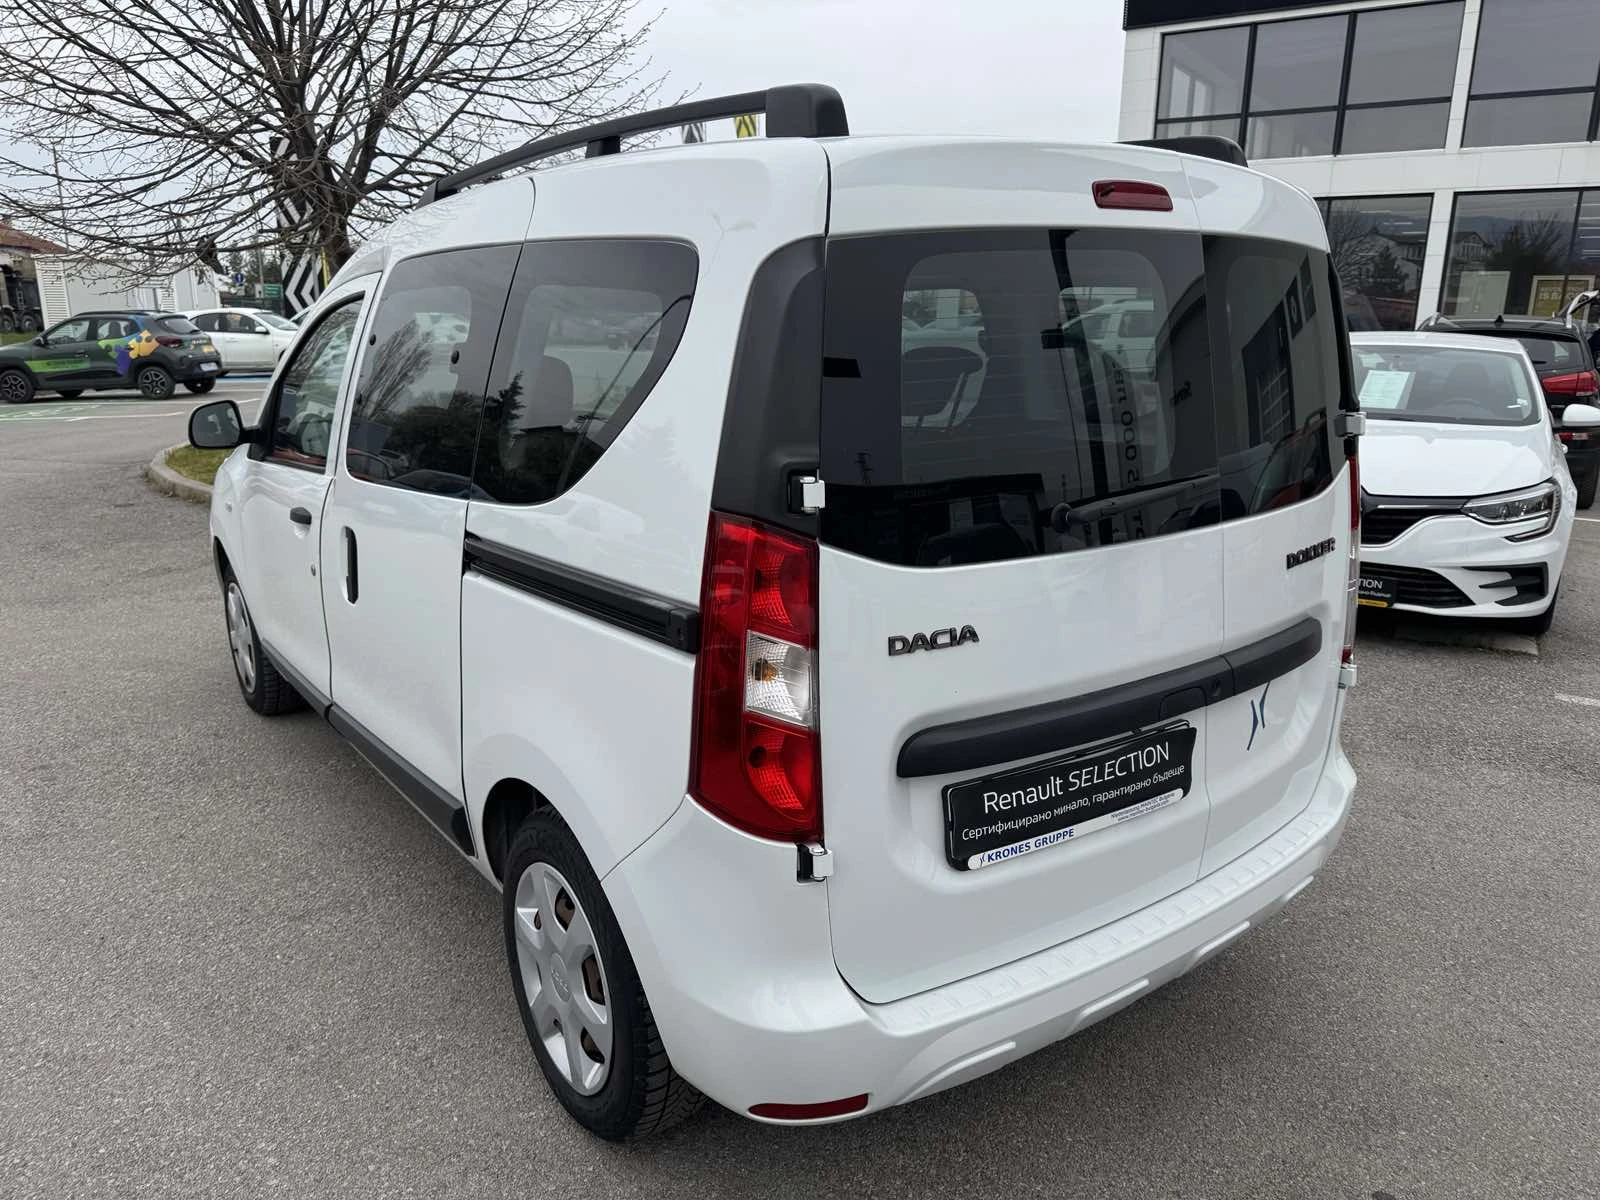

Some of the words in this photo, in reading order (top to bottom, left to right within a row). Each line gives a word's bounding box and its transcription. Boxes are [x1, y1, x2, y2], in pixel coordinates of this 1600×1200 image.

[1286, 537, 1336, 570] DOKKER
[1357, 578, 1383, 589] TION
[888, 625, 980, 656] DACIA
[984, 776, 1064, 814] Renault
[1068, 741, 1170, 791] SELECTION
[962, 810, 1052, 841] Сертифицирано
[1053, 796, 1091, 817] минало,
[1092, 779, 1151, 804] гарантирано
[1152, 765, 1185, 784] бъдеще
[987, 839, 1031, 863] KRONES
[1034, 828, 1075, 848] GRUPPE
